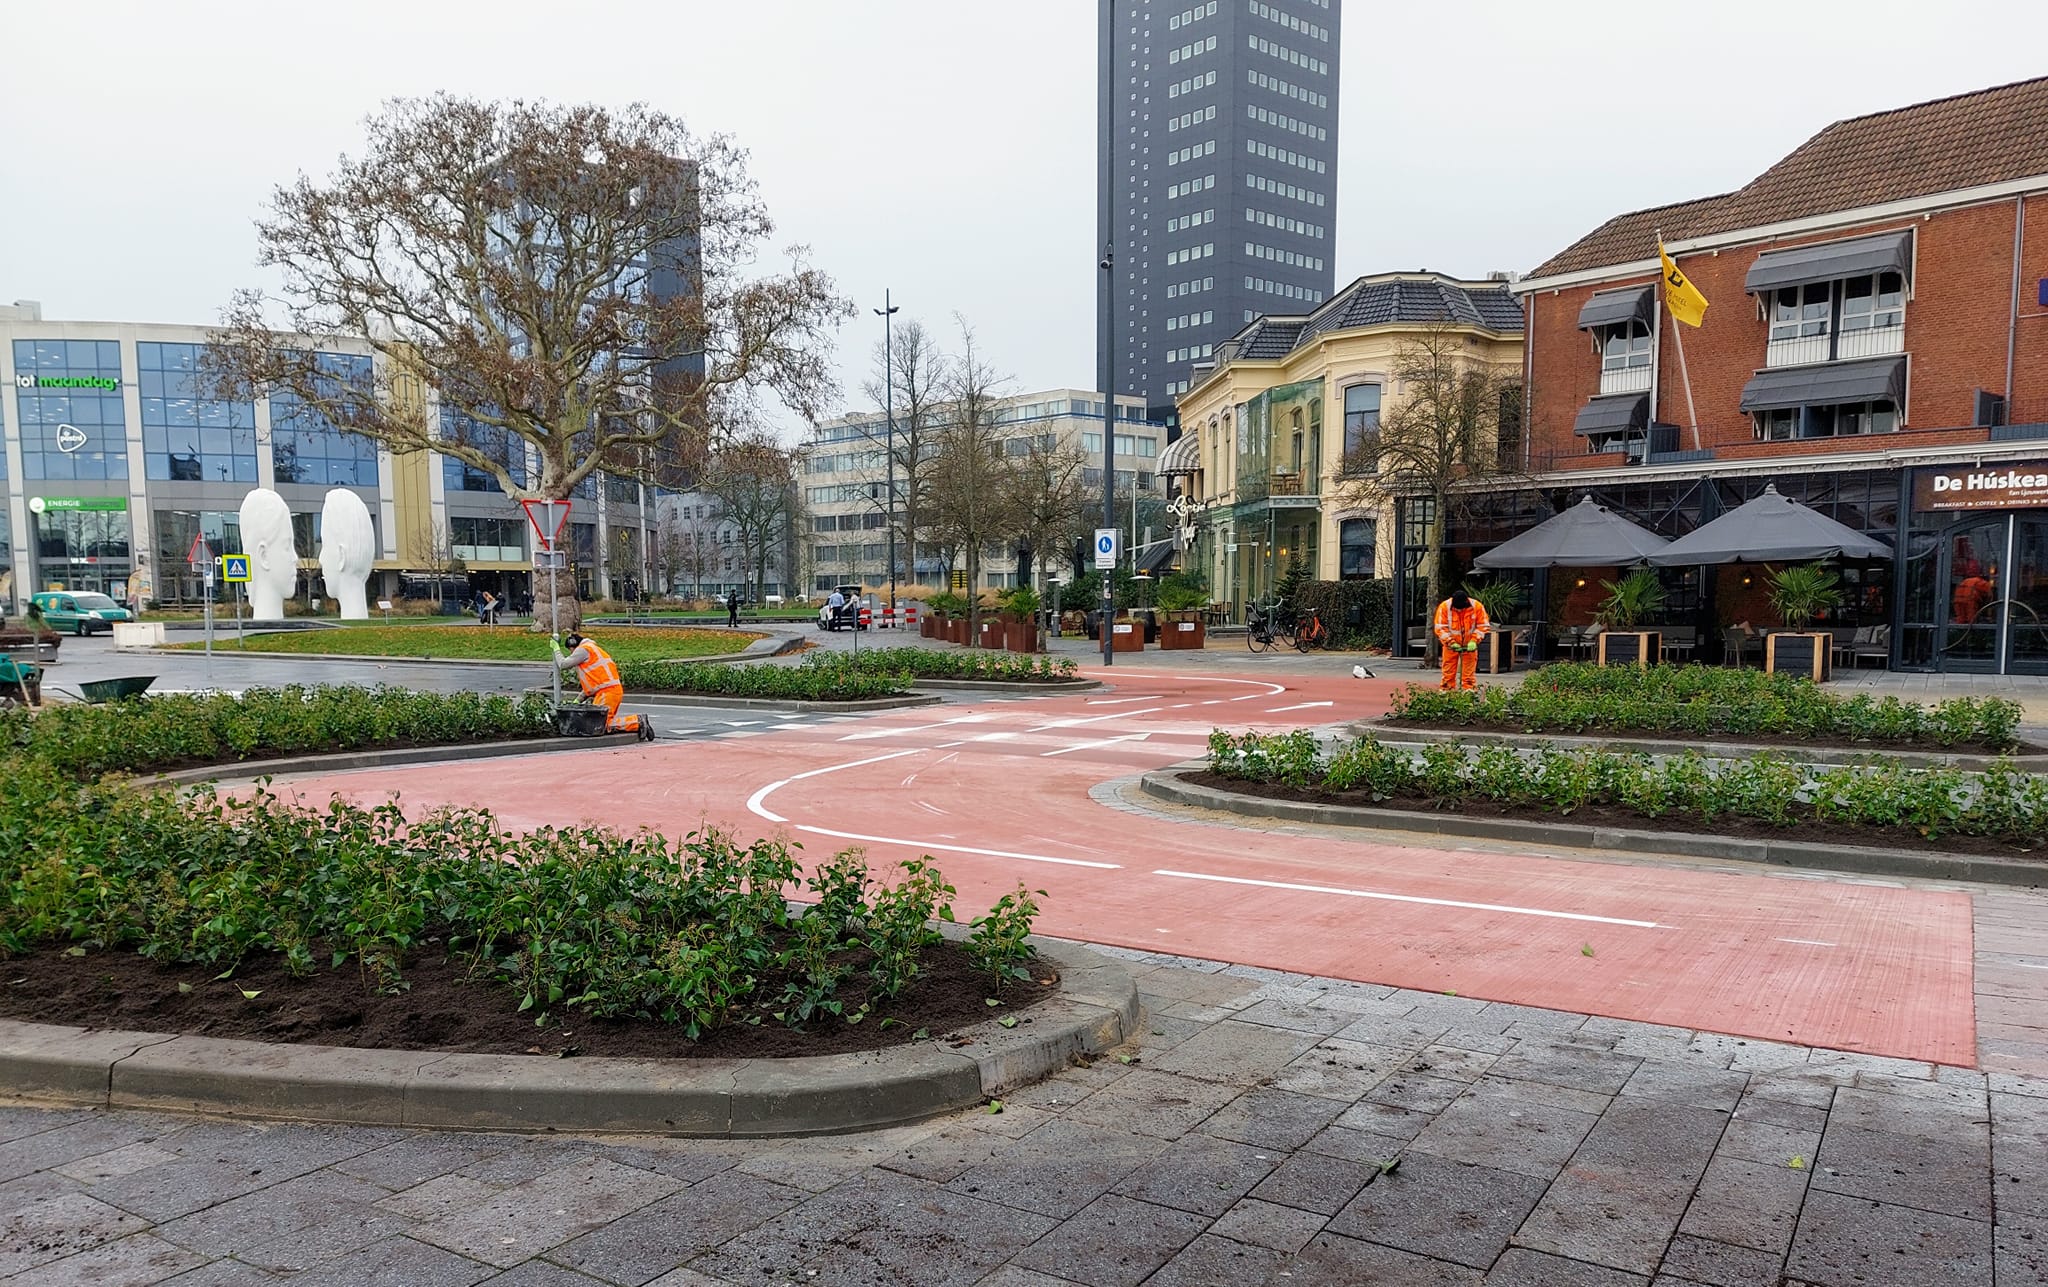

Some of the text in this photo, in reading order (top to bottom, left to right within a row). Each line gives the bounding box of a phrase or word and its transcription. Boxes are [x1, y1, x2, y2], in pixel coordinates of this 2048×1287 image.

[16, 375, 116, 391] tot maandag
[1934, 471, 2048, 491] De Húskea
